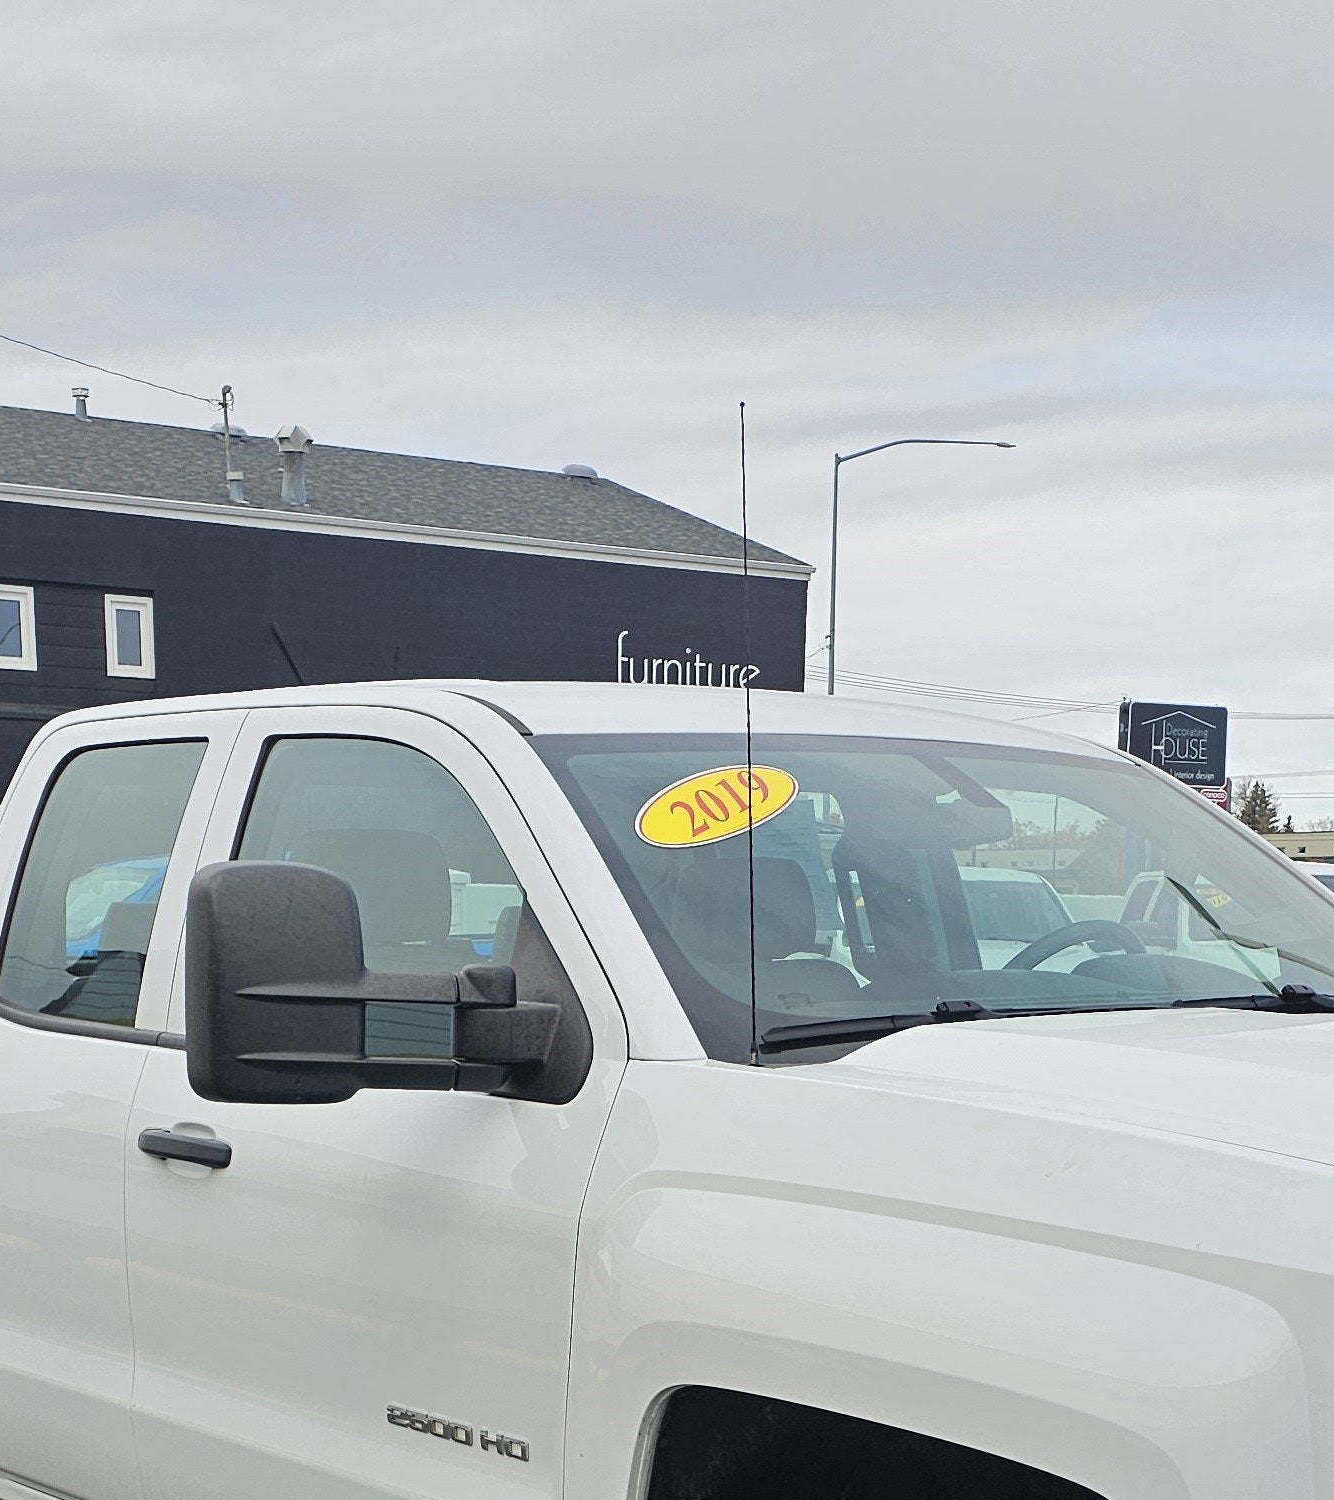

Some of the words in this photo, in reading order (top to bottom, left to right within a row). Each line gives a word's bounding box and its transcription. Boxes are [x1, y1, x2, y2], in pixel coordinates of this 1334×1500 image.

[618, 630, 761, 689] furniture
[1151, 720, 1208, 765] HOUSE
[1166, 722, 1208, 737] Decorating
[670, 770, 769, 838] 2019
[386, 1403, 473, 1446] 2500
[480, 1426, 529, 1462] HD
